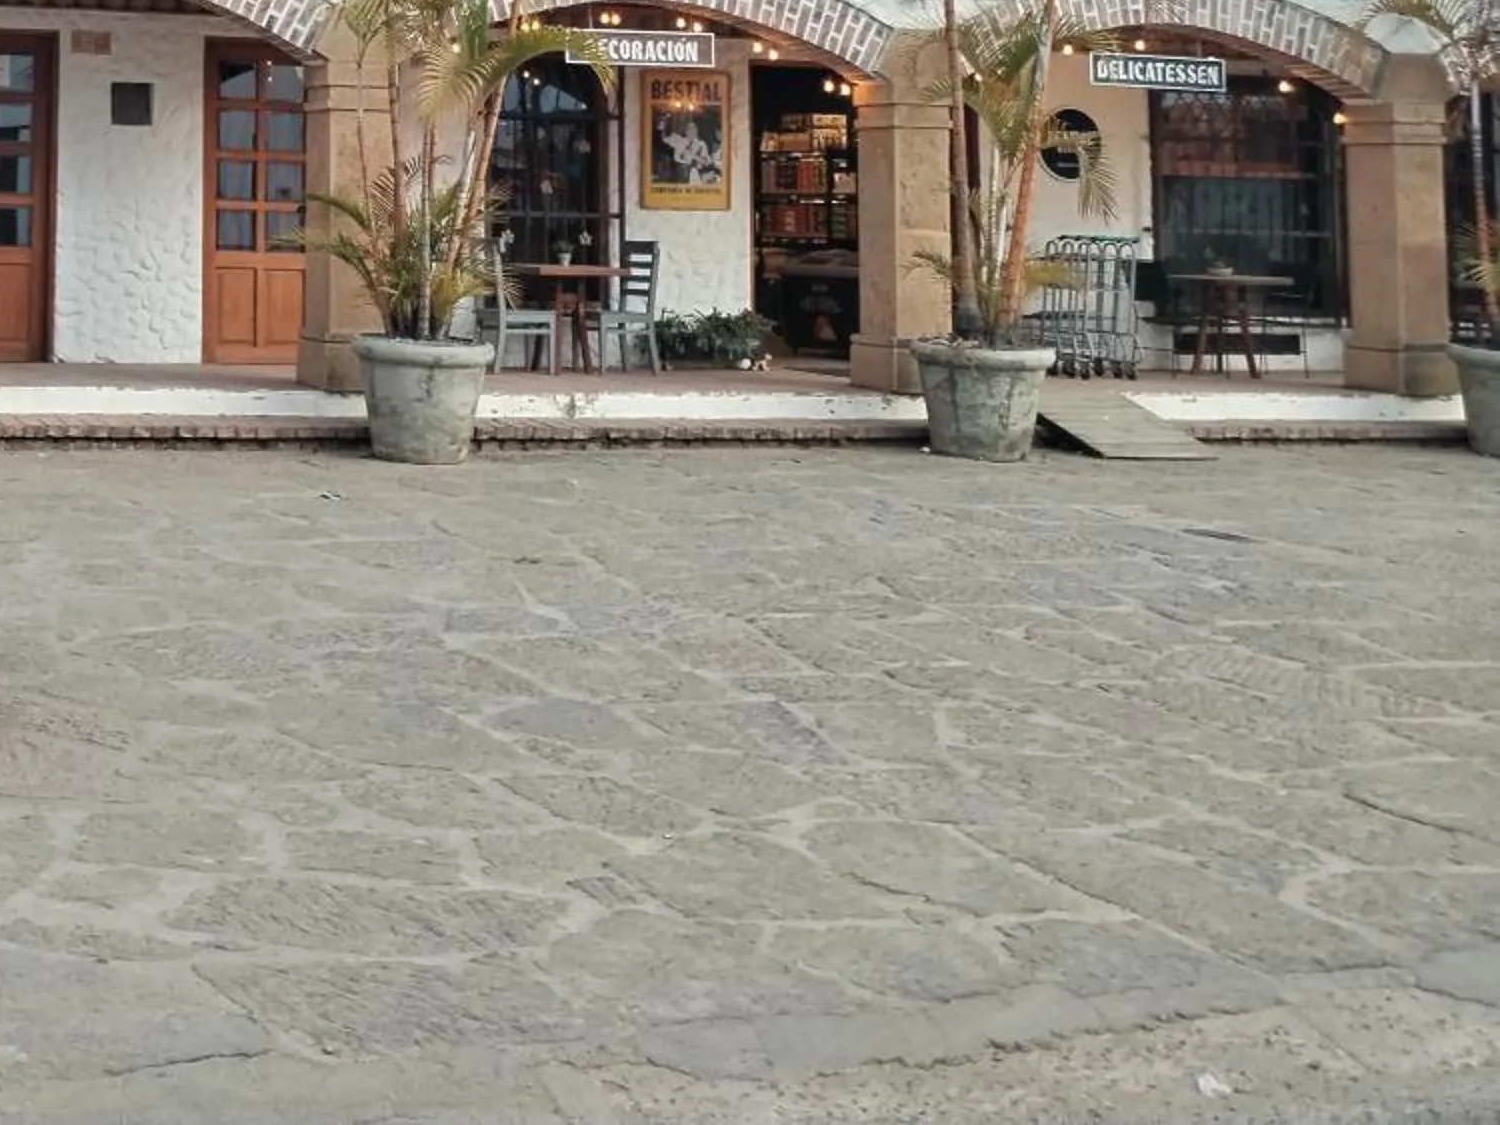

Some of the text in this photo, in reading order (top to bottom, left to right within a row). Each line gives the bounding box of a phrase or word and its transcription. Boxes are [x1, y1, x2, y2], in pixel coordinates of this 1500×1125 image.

[583, 37, 698, 62] ECORACIÓN
[1097, 60, 1219, 85] DELICATESSEN
[651, 79, 721, 101] BESTIAL
